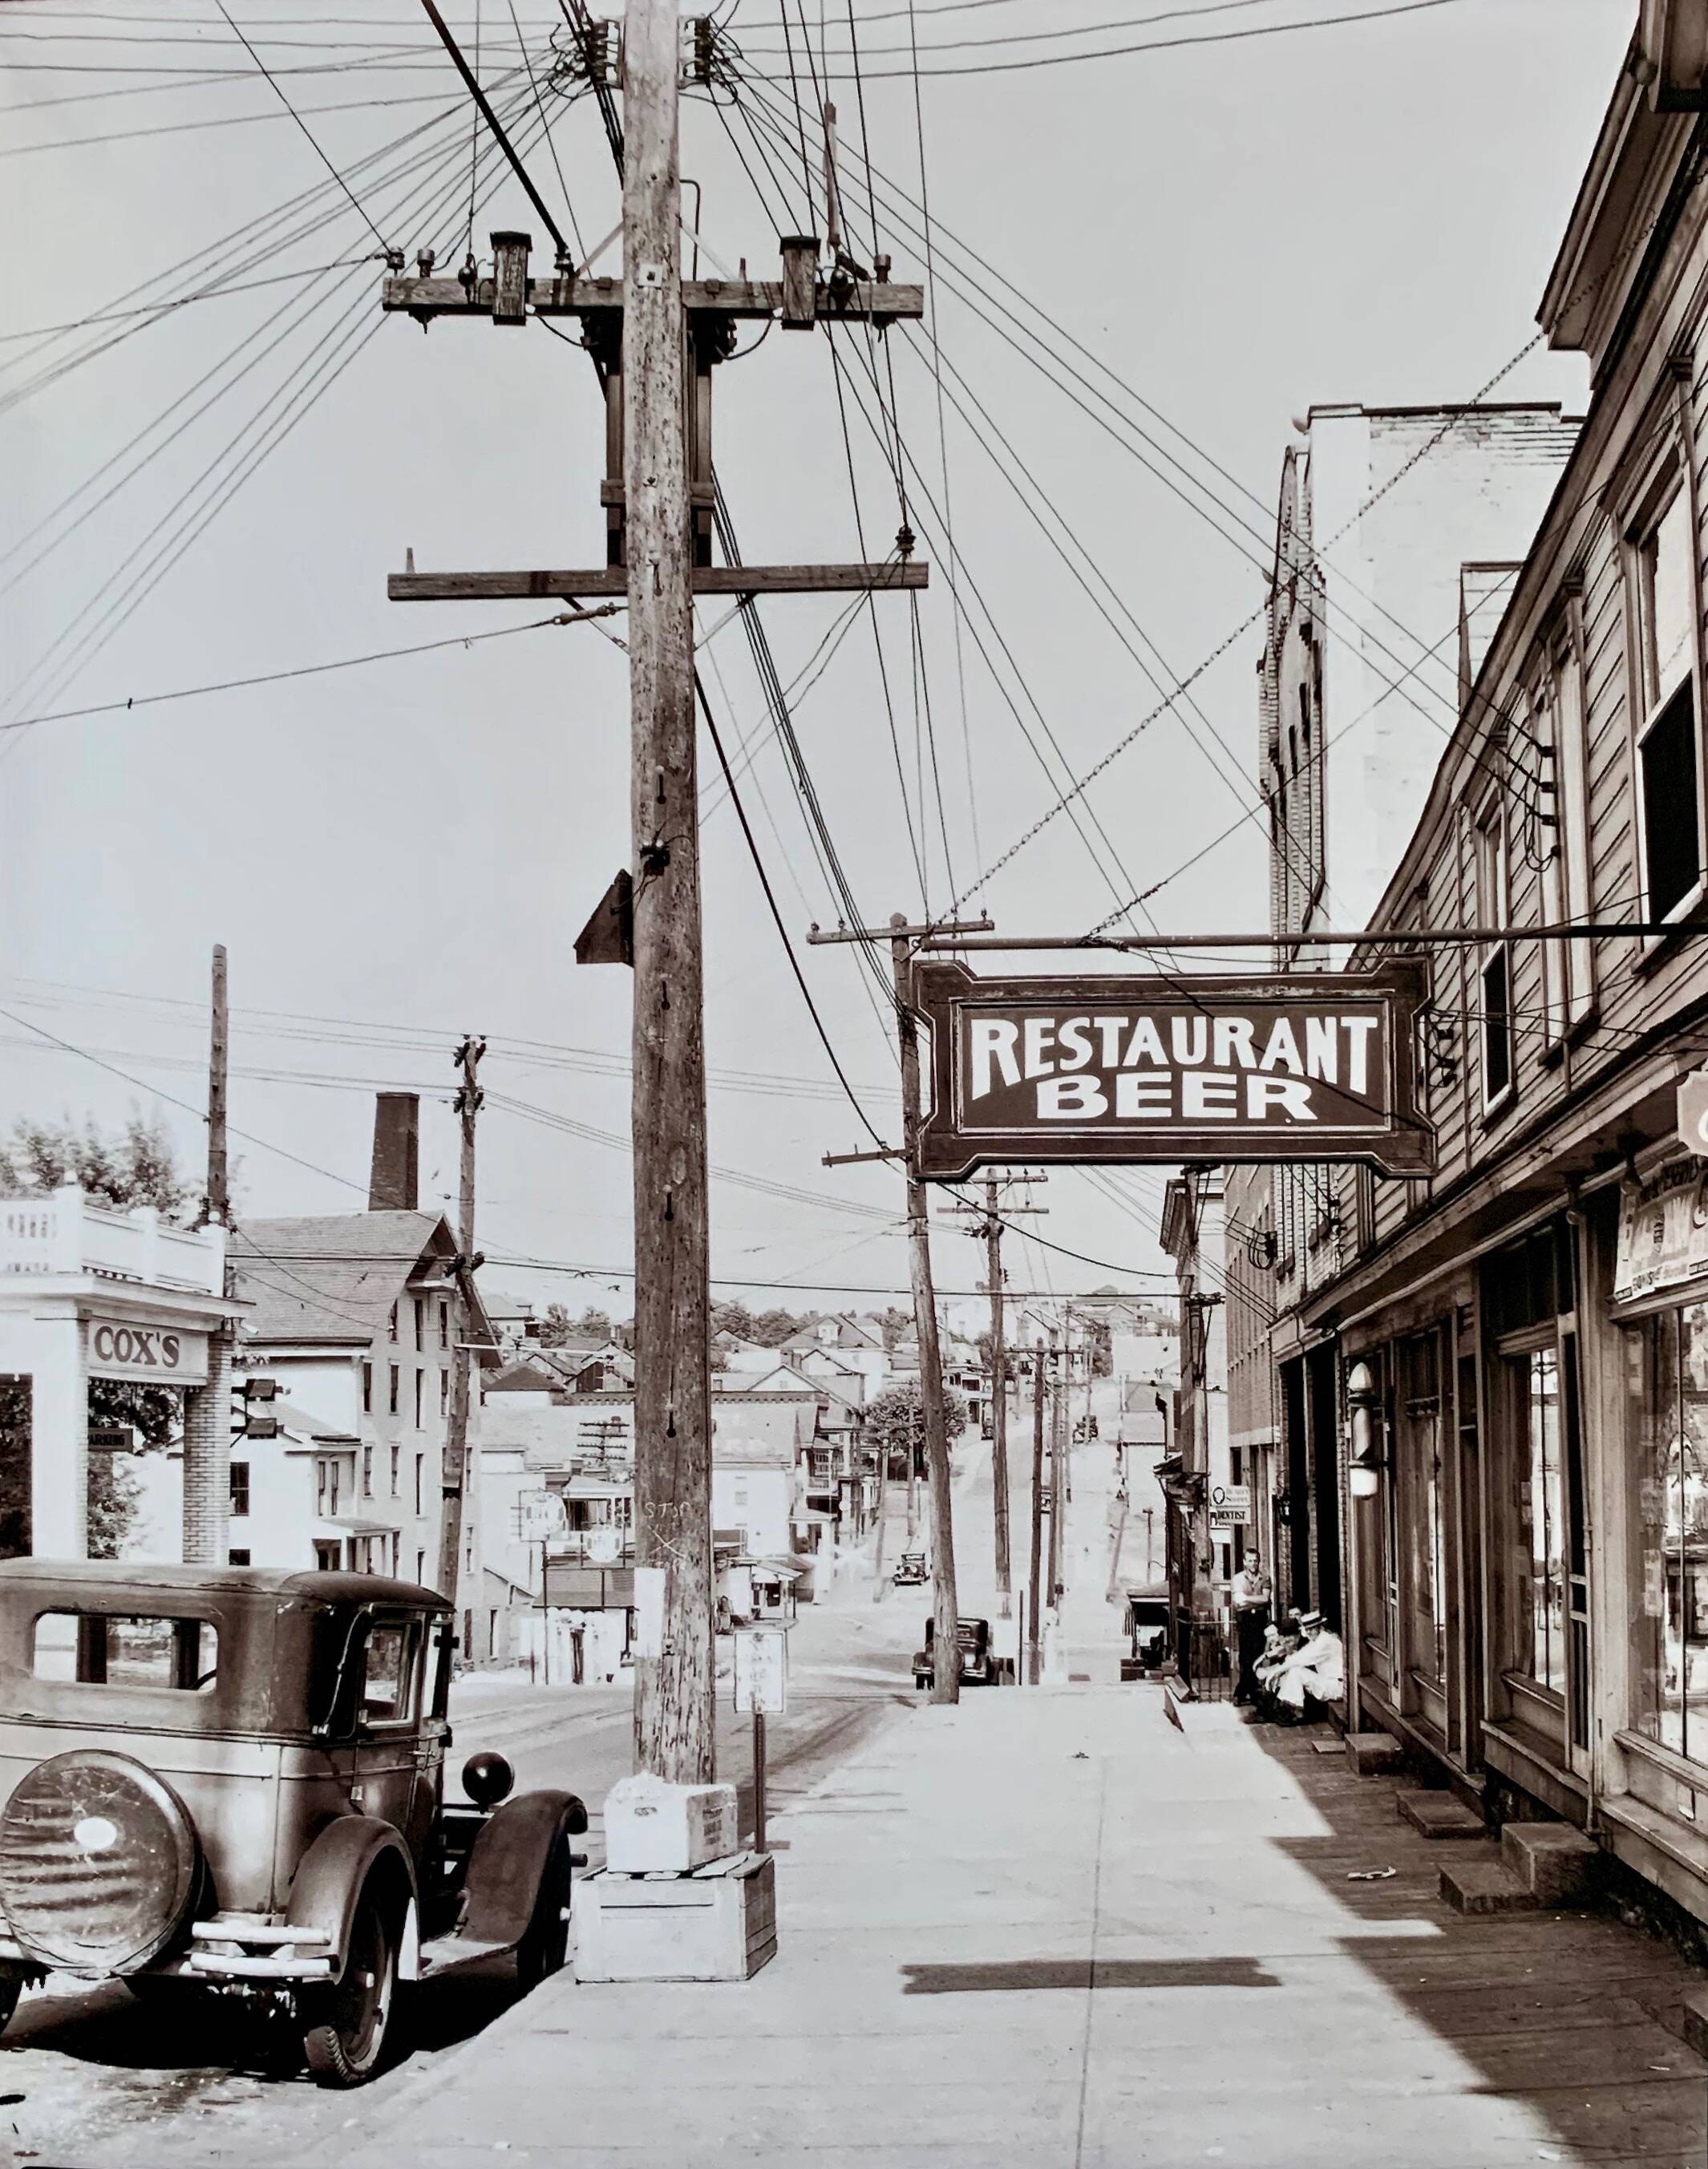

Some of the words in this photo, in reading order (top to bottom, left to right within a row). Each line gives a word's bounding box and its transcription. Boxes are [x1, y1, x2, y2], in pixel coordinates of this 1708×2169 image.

[971, 1017, 1378, 1101] RESTAURANT
[1036, 1070, 1319, 1120] BEER
[94, 1325, 180, 1368] COX'S
[1217, 1511, 1245, 1520] DENTIST
